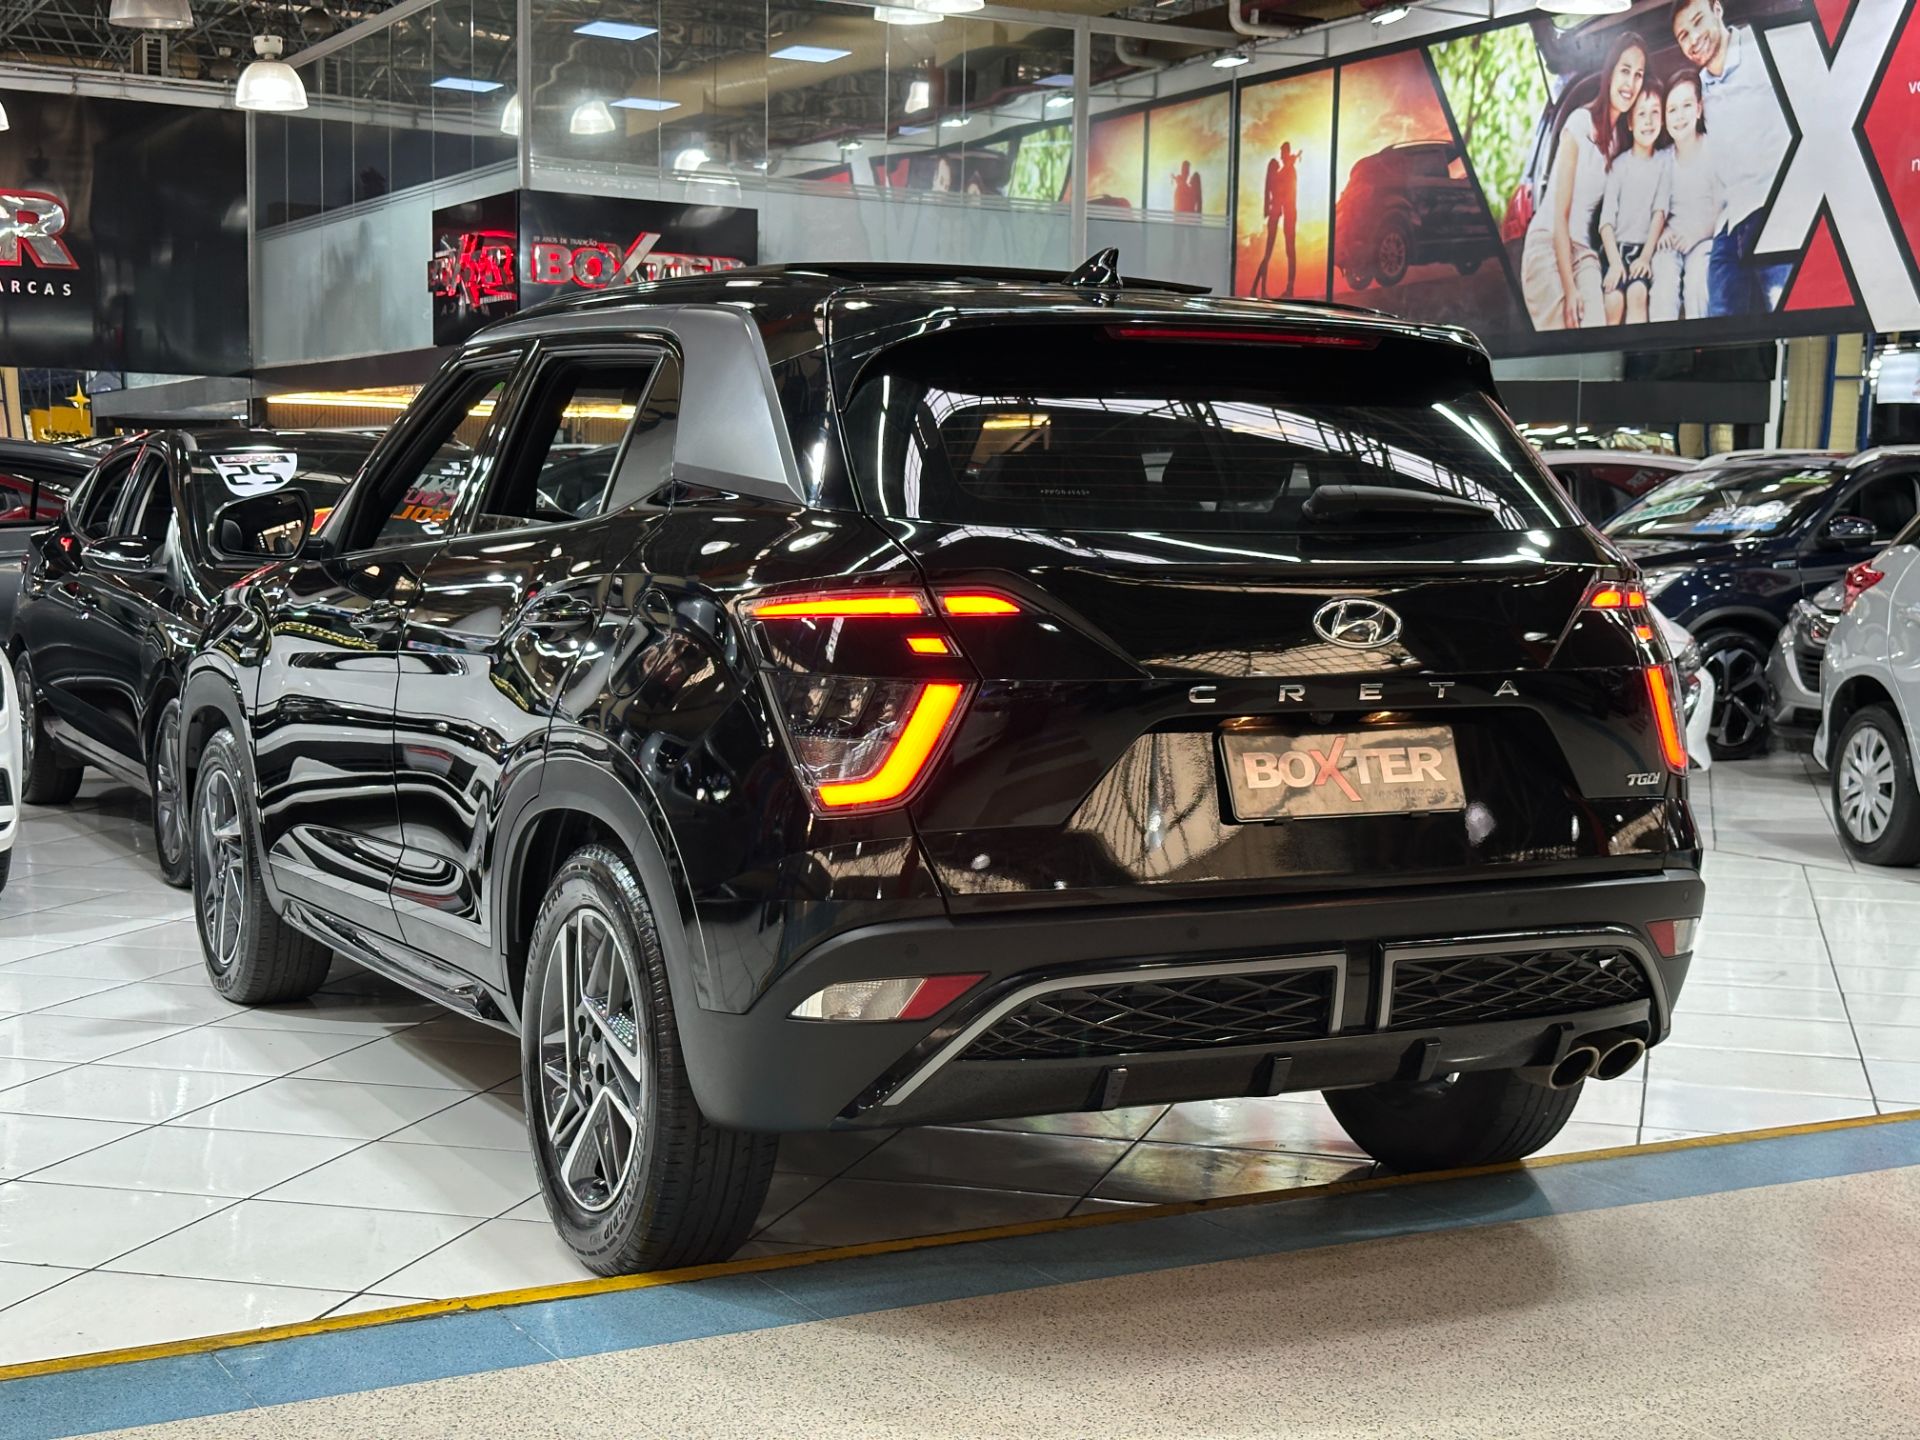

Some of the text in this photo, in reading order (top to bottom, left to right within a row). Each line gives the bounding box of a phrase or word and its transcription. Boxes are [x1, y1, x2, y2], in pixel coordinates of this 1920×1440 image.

[222, 463, 285, 486] 25
[1188, 679, 1520, 704] CRETA
[1242, 736, 1447, 802] BOXTER
